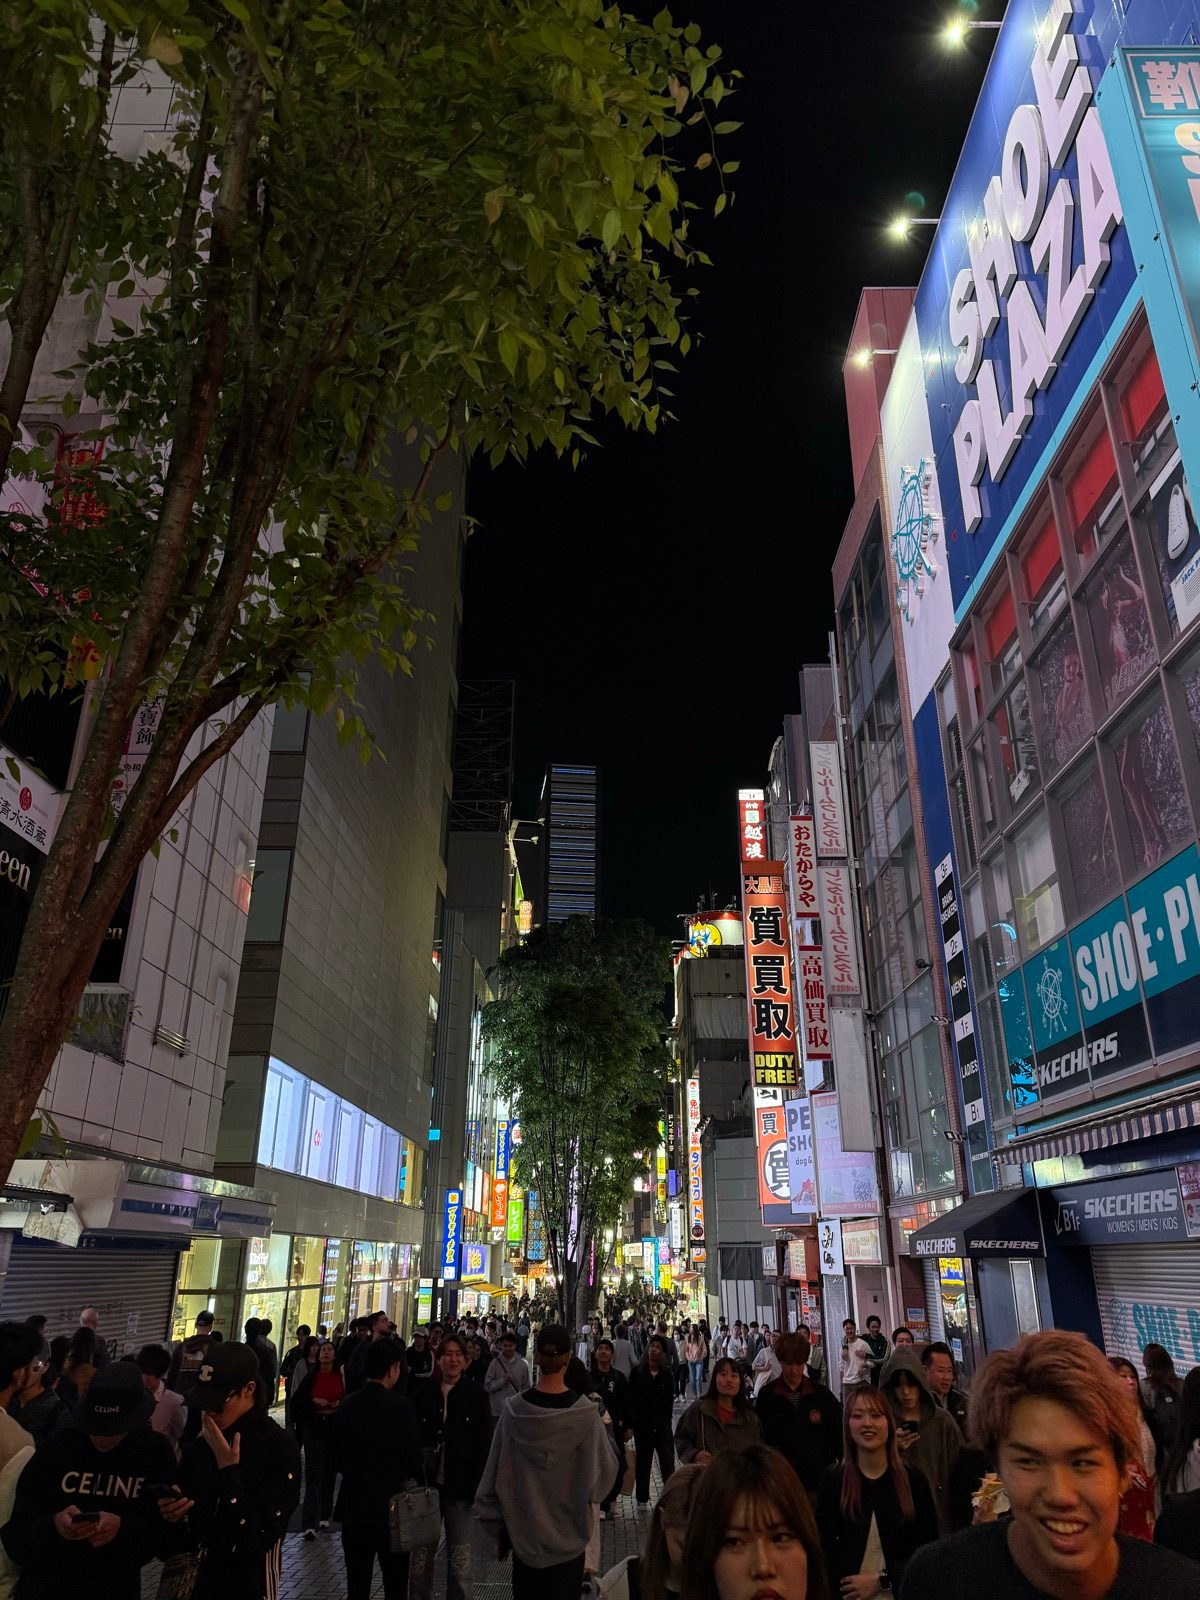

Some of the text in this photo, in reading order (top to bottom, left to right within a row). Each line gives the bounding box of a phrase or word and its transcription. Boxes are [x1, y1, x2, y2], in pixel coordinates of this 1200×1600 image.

[950, 0, 1093, 386] SHOE
[953, 106, 1124, 534] PLAZA
[794, 824, 816, 908] おたからや
[939, 863, 949, 879] 3F
[745, 876, 785, 894] 大黒屋
[949, 940, 959, 956] 2F
[749, 905, 793, 1040] 質買取
[950, 975, 967, 997] MEN'S
[802, 955, 830, 1048] 高価買取
[960, 1019, 969, 1035] 1F
[755, 1054, 794, 1068] DUTY
[961, 1059, 978, 1079] LADIES
[1031, 1032, 1118, 1090] SKECHERS
[756, 1069, 796, 1084] FREE
[971, 1151, 989, 1161] SKECHERS
[1084, 1187, 1180, 1219] SKECHERS
[510, 1208, 519, 1233] レイク
[1063, 1208, 1081, 1233] B1F
[1107, 1216, 1179, 1233] WOMEN'S MEN'S KIDS
[916, 1237, 956, 1255] SKECHERS
[969, 1239, 1039, 1250] SKECHERS
[94, 1405, 121, 1414] CELINE
[61, 1470, 145, 1500] CELINE
